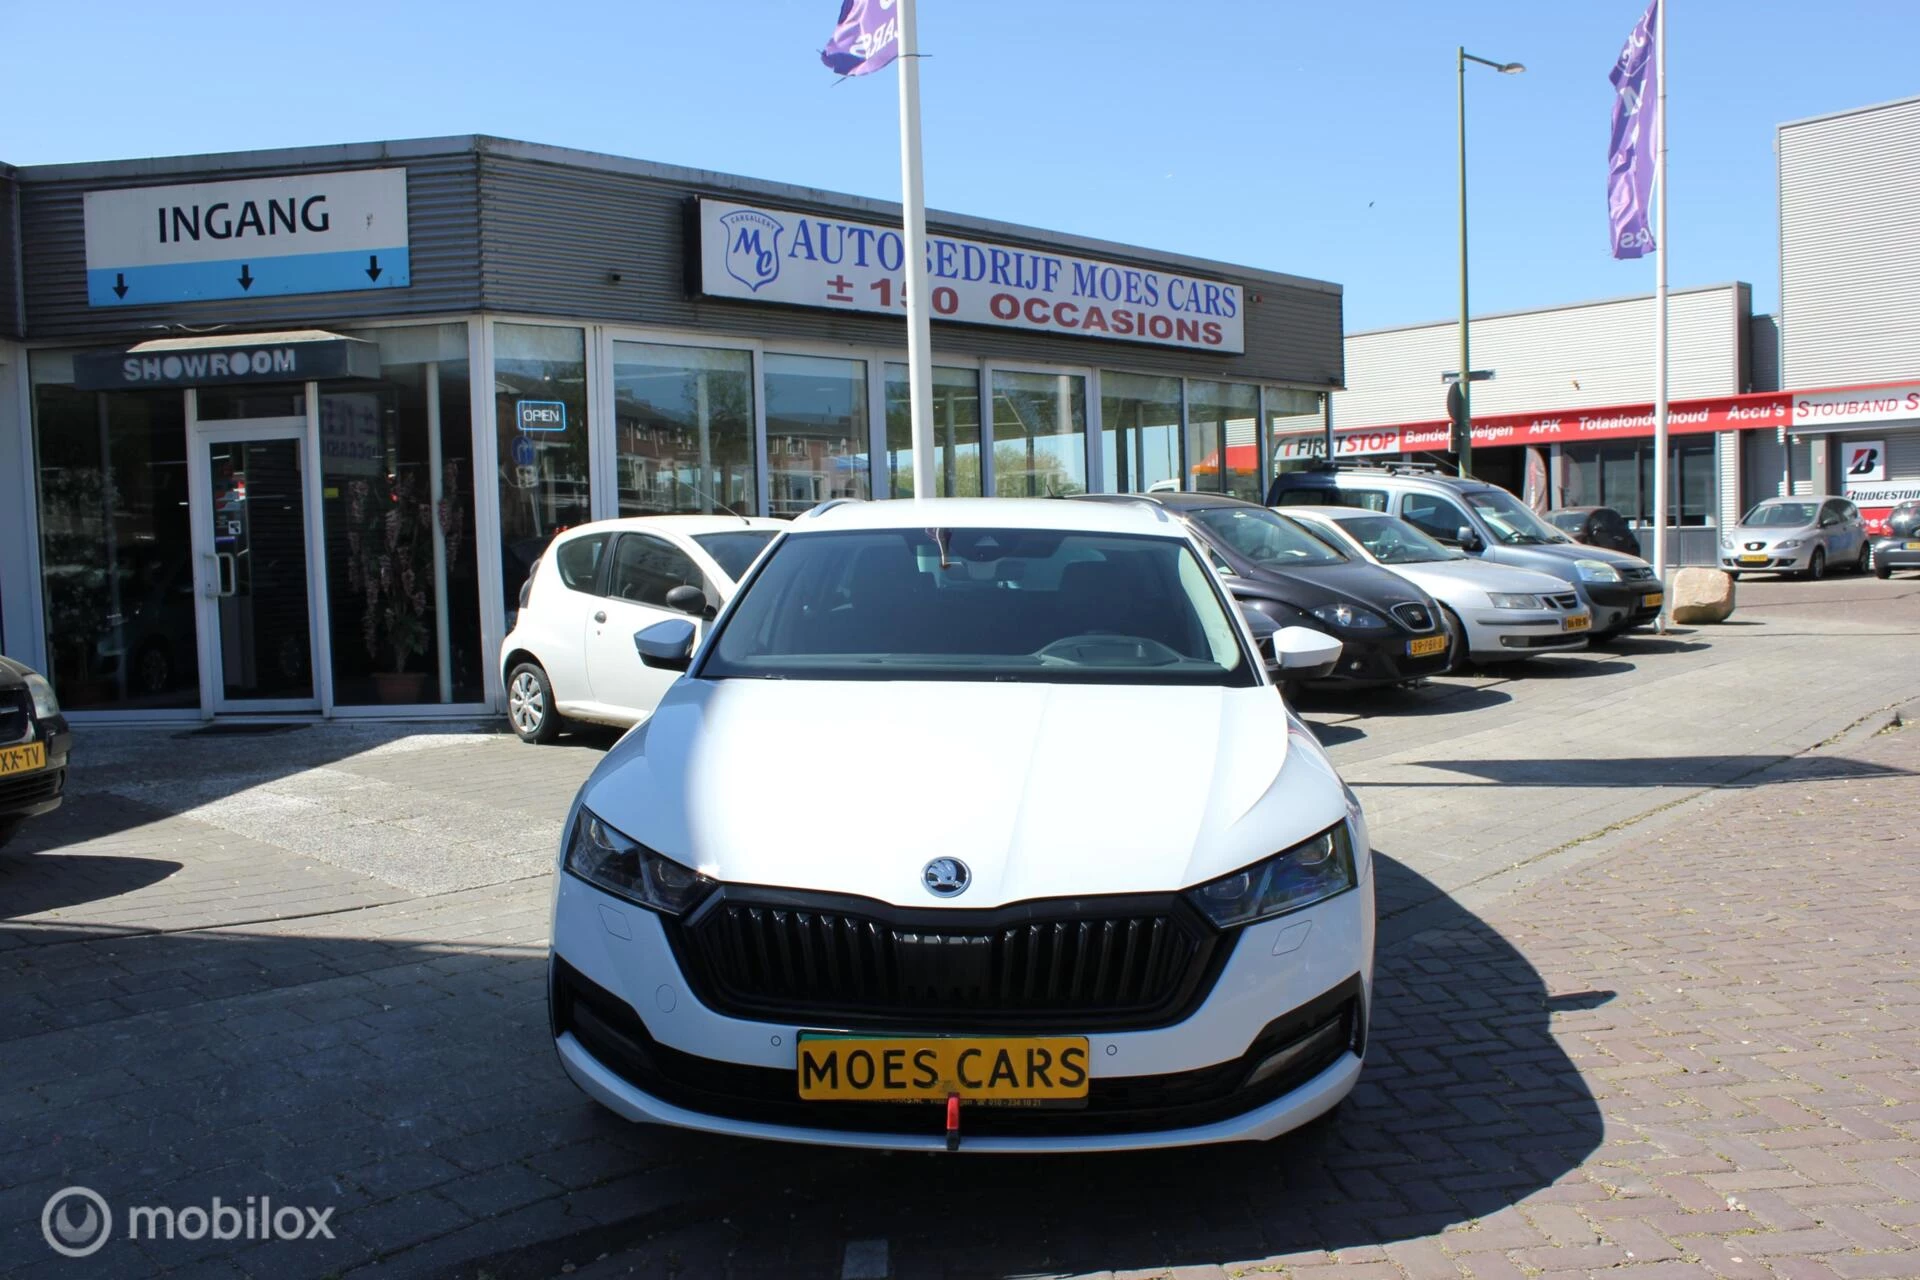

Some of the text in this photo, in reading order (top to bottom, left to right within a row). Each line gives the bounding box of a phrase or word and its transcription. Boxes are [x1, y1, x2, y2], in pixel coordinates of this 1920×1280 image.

[158, 194, 330, 244] INGANG
[1071, 260, 1160, 308] MOES
[1167, 278, 1237, 319] CARS
[990, 292, 1224, 346] OCCASIONS
[123, 350, 296, 381] SHOWROOM
[523, 409, 560, 422] OPEN
[1294, 432, 1396, 456] FIRTSTOP
[1529, 418, 1562, 434] APK
[1579, 408, 1709, 431] Totaalondhoud
[1726, 402, 1785, 420] Accu's
[1797, 399, 1899, 418] STOUBAND
[803, 1048, 1086, 1090] MOES CARS
